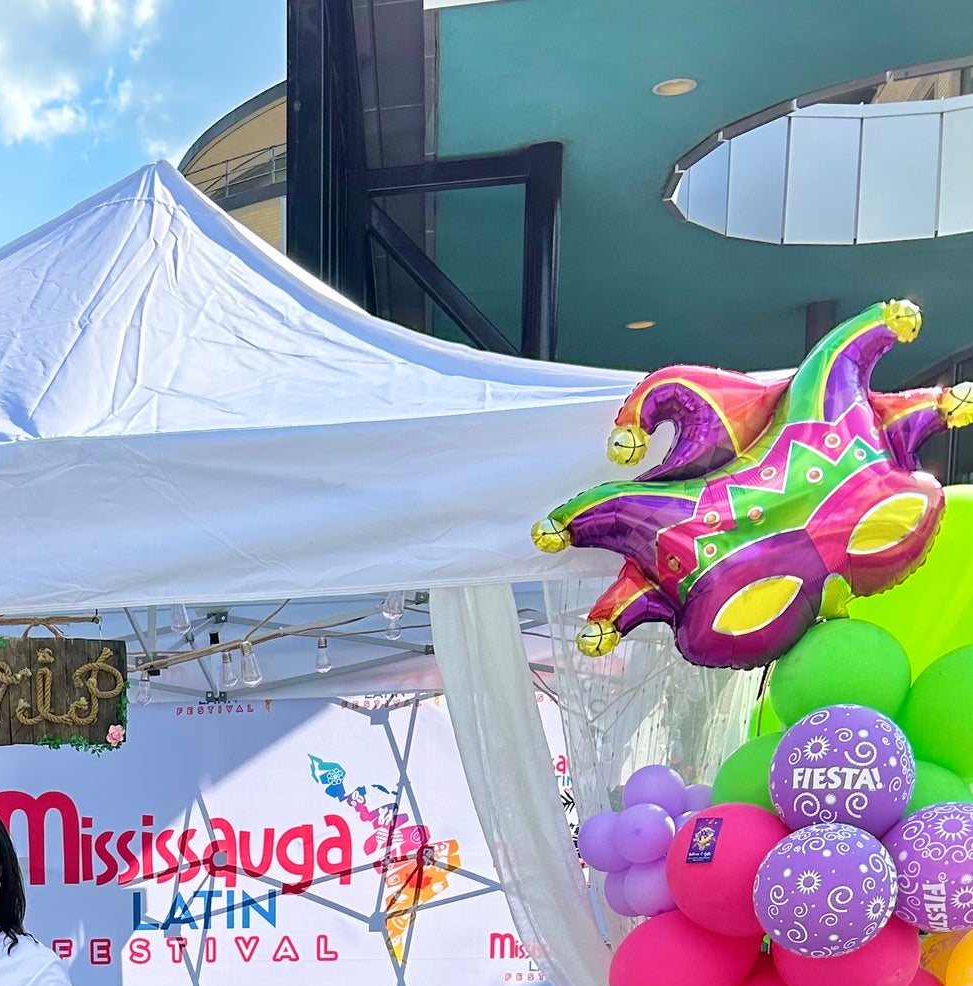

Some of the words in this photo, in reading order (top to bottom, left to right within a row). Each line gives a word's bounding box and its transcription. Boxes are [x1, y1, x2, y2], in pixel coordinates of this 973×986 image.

[176, 704, 254, 715] FESTIVAL
[791, 766, 884, 791] FIESTA!
[132, 888, 277, 931] LATIN
[52, 934, 339, 965] FESTIVAL
